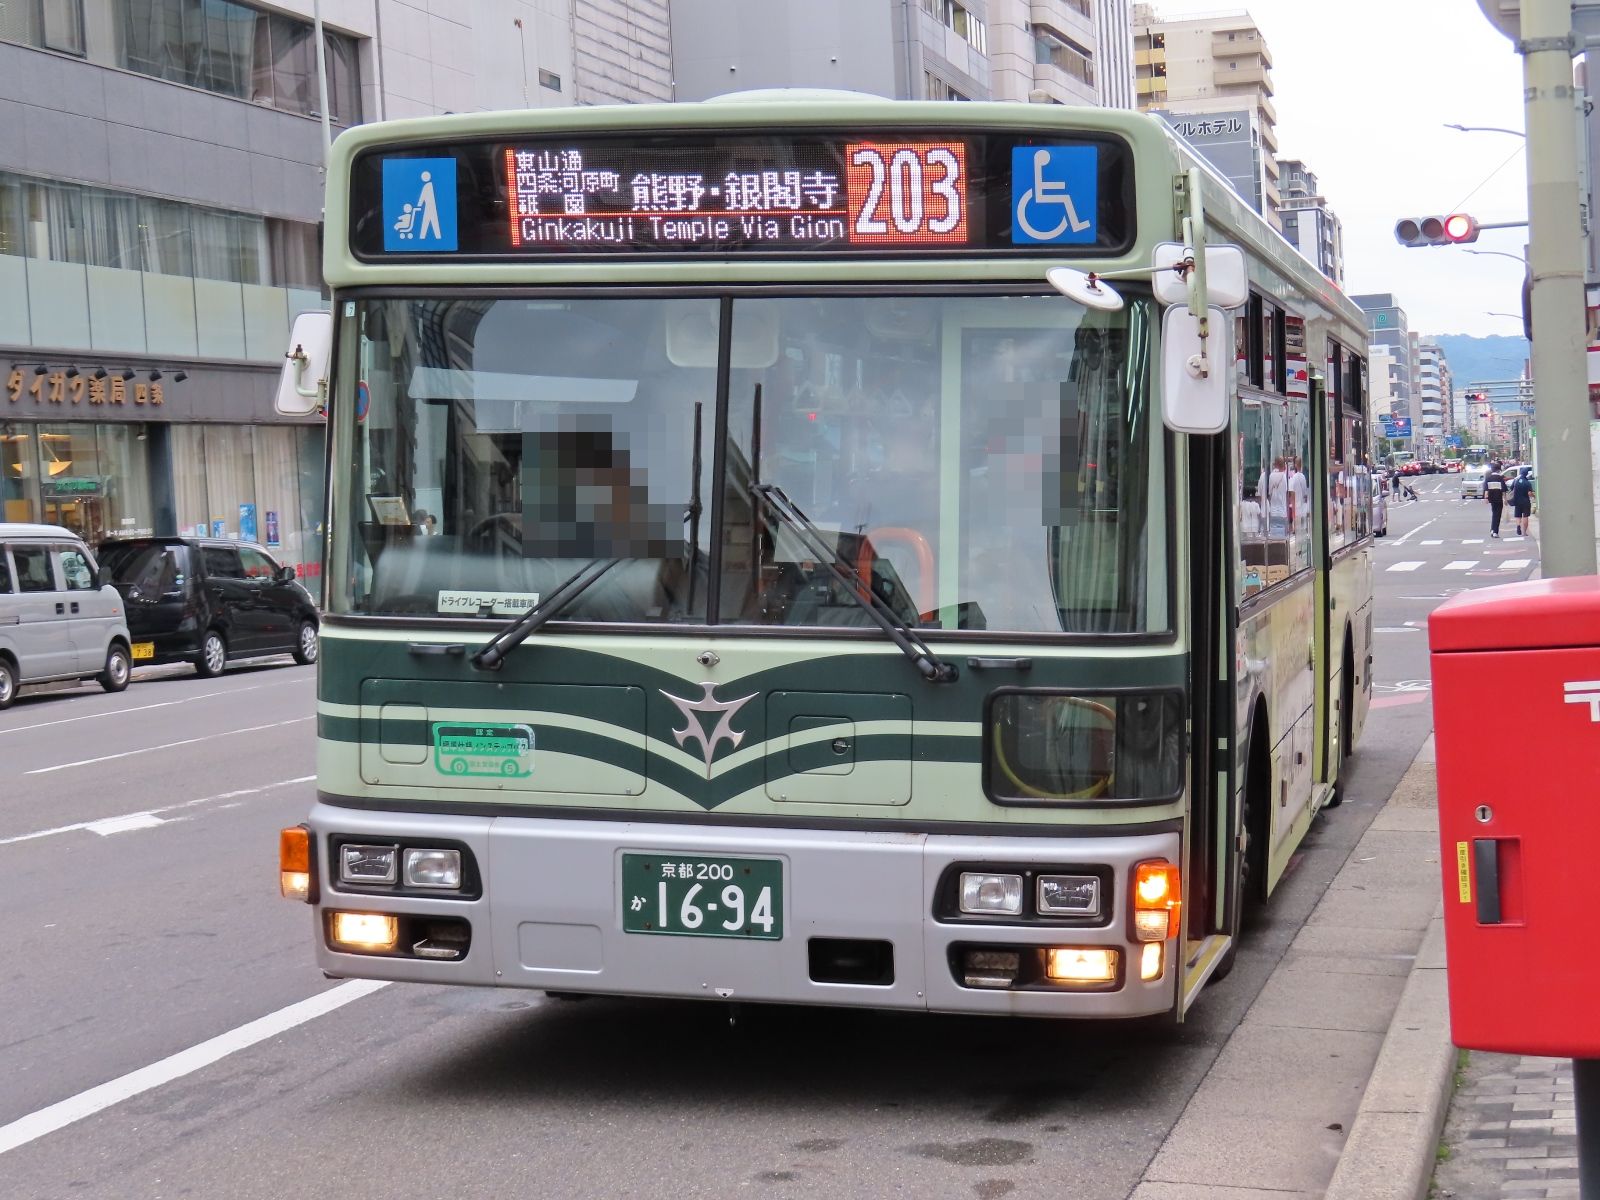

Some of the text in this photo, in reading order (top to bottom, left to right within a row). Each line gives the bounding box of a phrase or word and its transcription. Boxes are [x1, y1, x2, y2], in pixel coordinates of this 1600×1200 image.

[516, 150, 582, 171] 東山通
[517, 172, 619, 193] 四条河原町
[853, 148, 961, 235] 203
[522, 215, 844, 242] Ginkakuji Temple Via Gion
[630, 881, 775, 933] か 16-94
